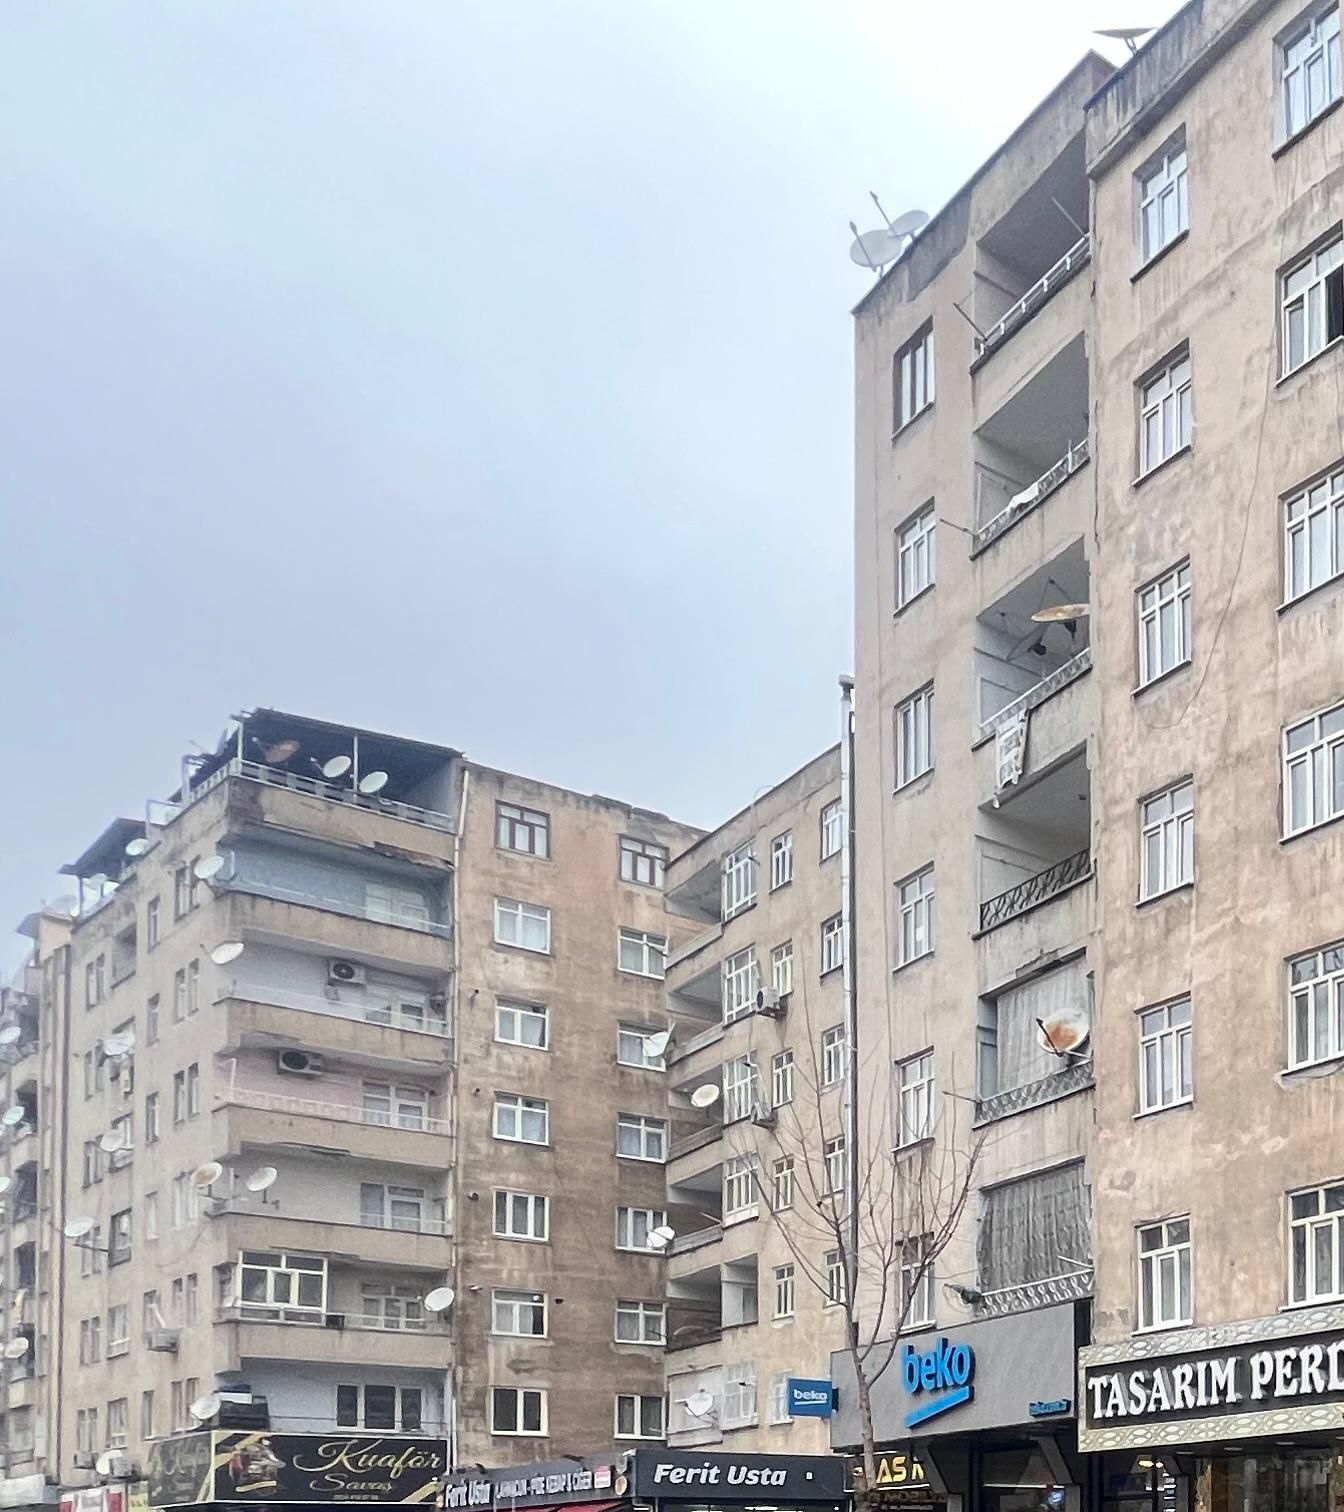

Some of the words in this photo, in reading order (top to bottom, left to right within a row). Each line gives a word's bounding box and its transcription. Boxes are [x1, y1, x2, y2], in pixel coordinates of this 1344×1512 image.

[902, 1337, 974, 1394] beko
[793, 1388, 829, 1400] beko
[1088, 1356, 1241, 1419] TASARIM
[293, 1438, 441, 1479] Kuaför
[654, 1462, 721, 1484] Ferit
[727, 1465, 788, 1486] Usta
